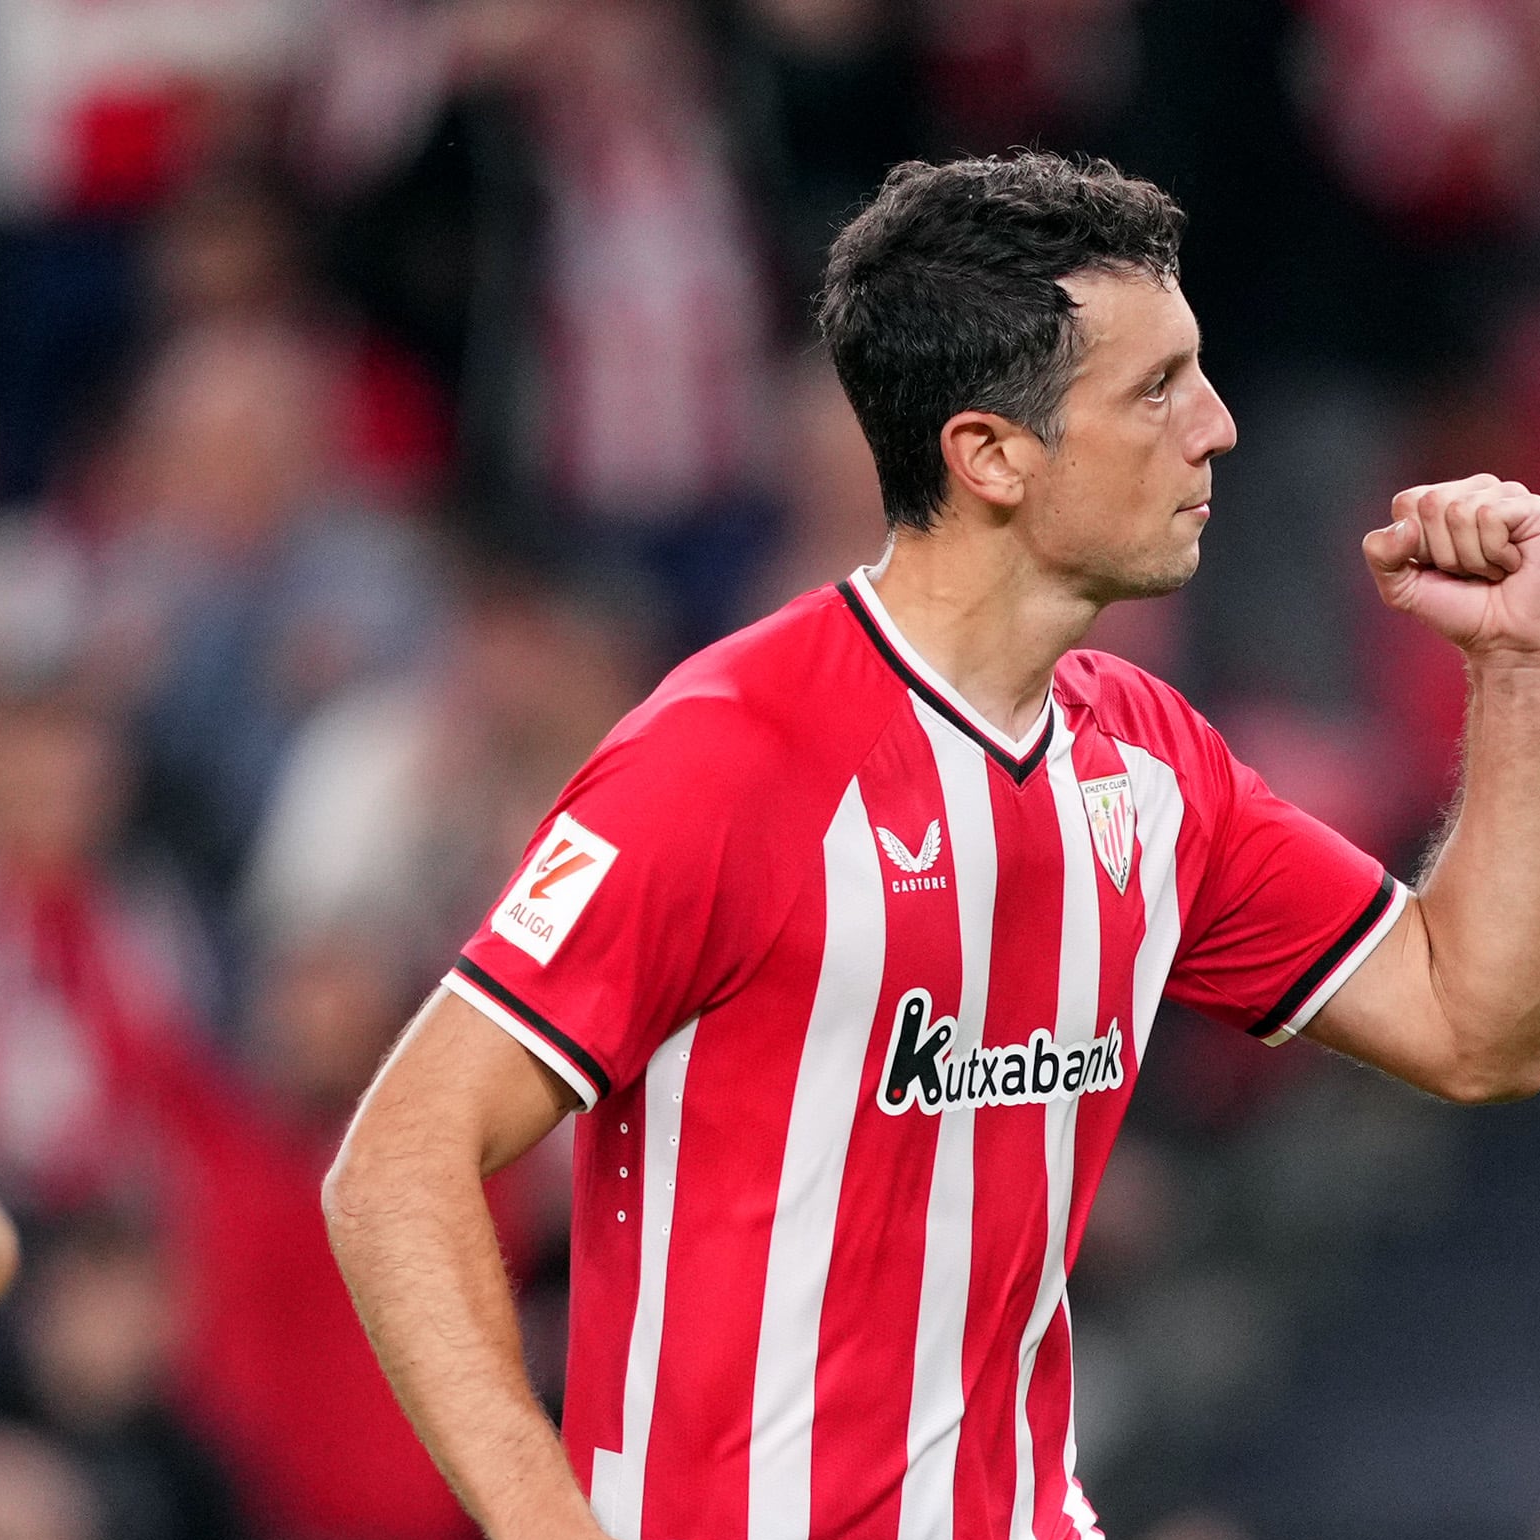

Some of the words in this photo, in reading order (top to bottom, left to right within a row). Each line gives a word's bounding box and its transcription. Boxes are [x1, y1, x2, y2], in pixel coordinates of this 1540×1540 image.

[1109, 779, 1127, 790] CLUB
[892, 876, 947, 893] CASTORE
[504, 902, 554, 943] ALIGA
[885, 997, 1119, 1106] Kutxabank
